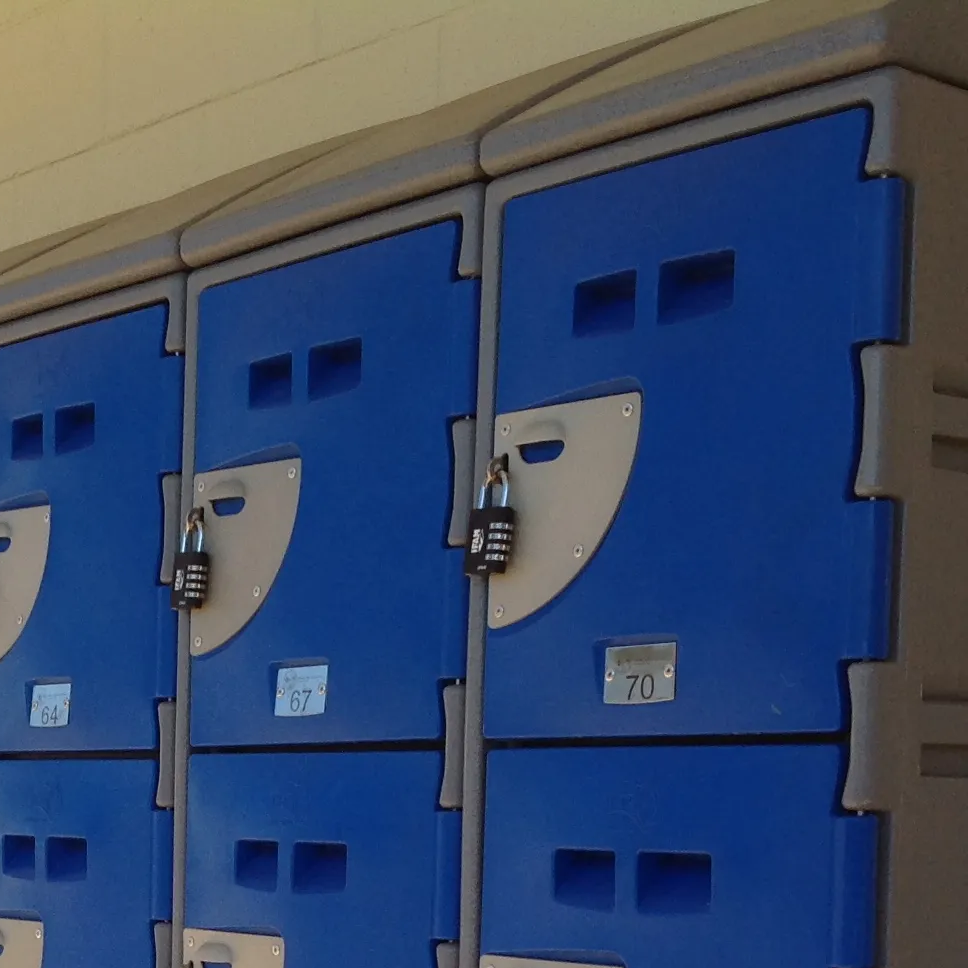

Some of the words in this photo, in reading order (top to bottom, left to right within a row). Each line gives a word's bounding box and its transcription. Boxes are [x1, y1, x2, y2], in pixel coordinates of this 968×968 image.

[626, 674, 655, 701] 70
[289, 688, 313, 713] 67
[41, 704, 59, 725] 64
